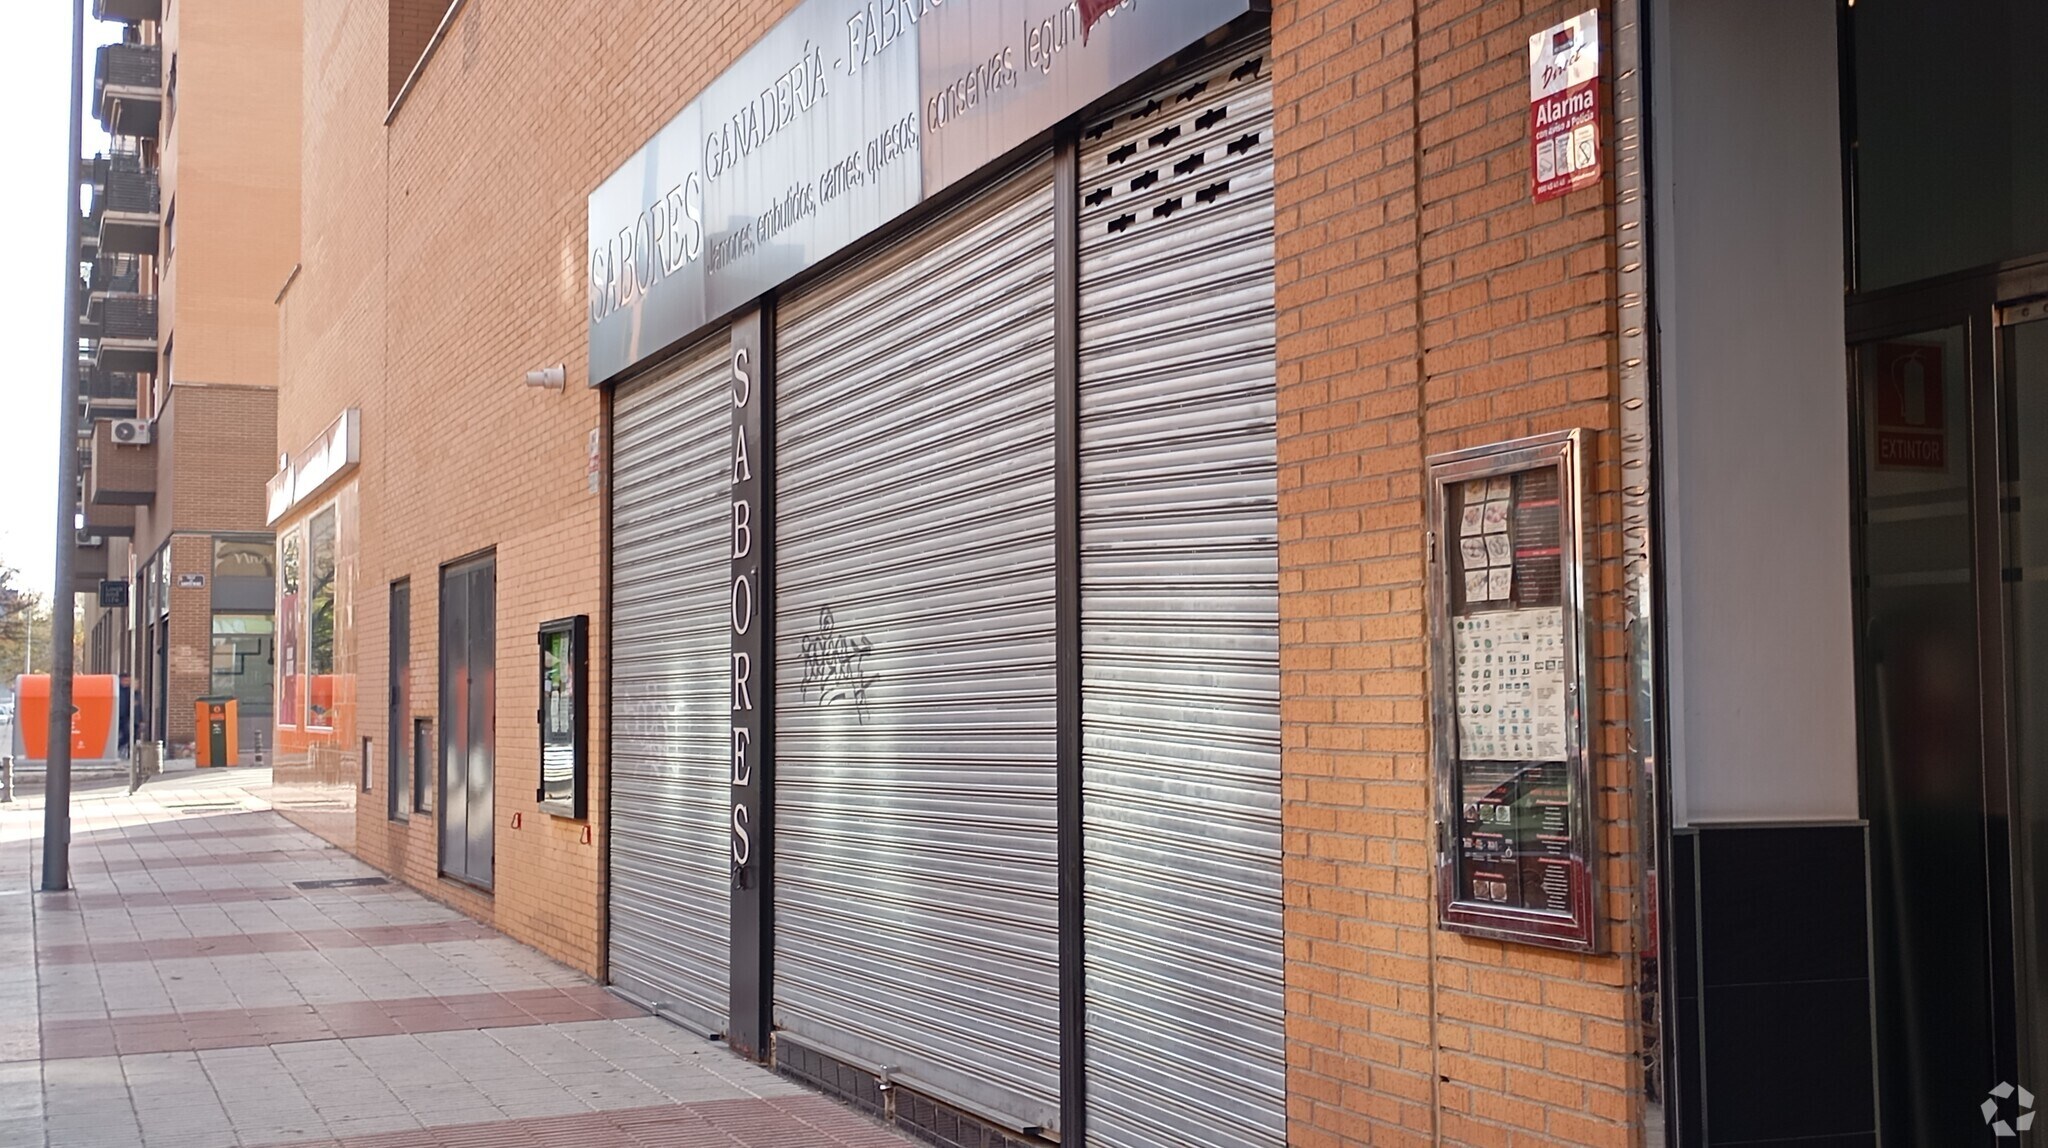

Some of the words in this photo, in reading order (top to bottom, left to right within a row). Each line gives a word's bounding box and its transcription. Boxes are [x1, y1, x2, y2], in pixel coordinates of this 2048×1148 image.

[705, 39, 829, 182] GANADERÍA
[847, 0, 943, 76] FABR
[757, 181, 817, 246] embutidos,
[819, 150, 865, 206] carnes,
[867, 112, 919, 184] quesos,
[927, 46, 1018, 134] conservas,
[1536, 89, 1594, 128] Alarma
[591, 171, 703, 325] SABORES
[1881, 438, 1941, 460] EXTINTOR
[732, 347, 752, 865] SABORES
